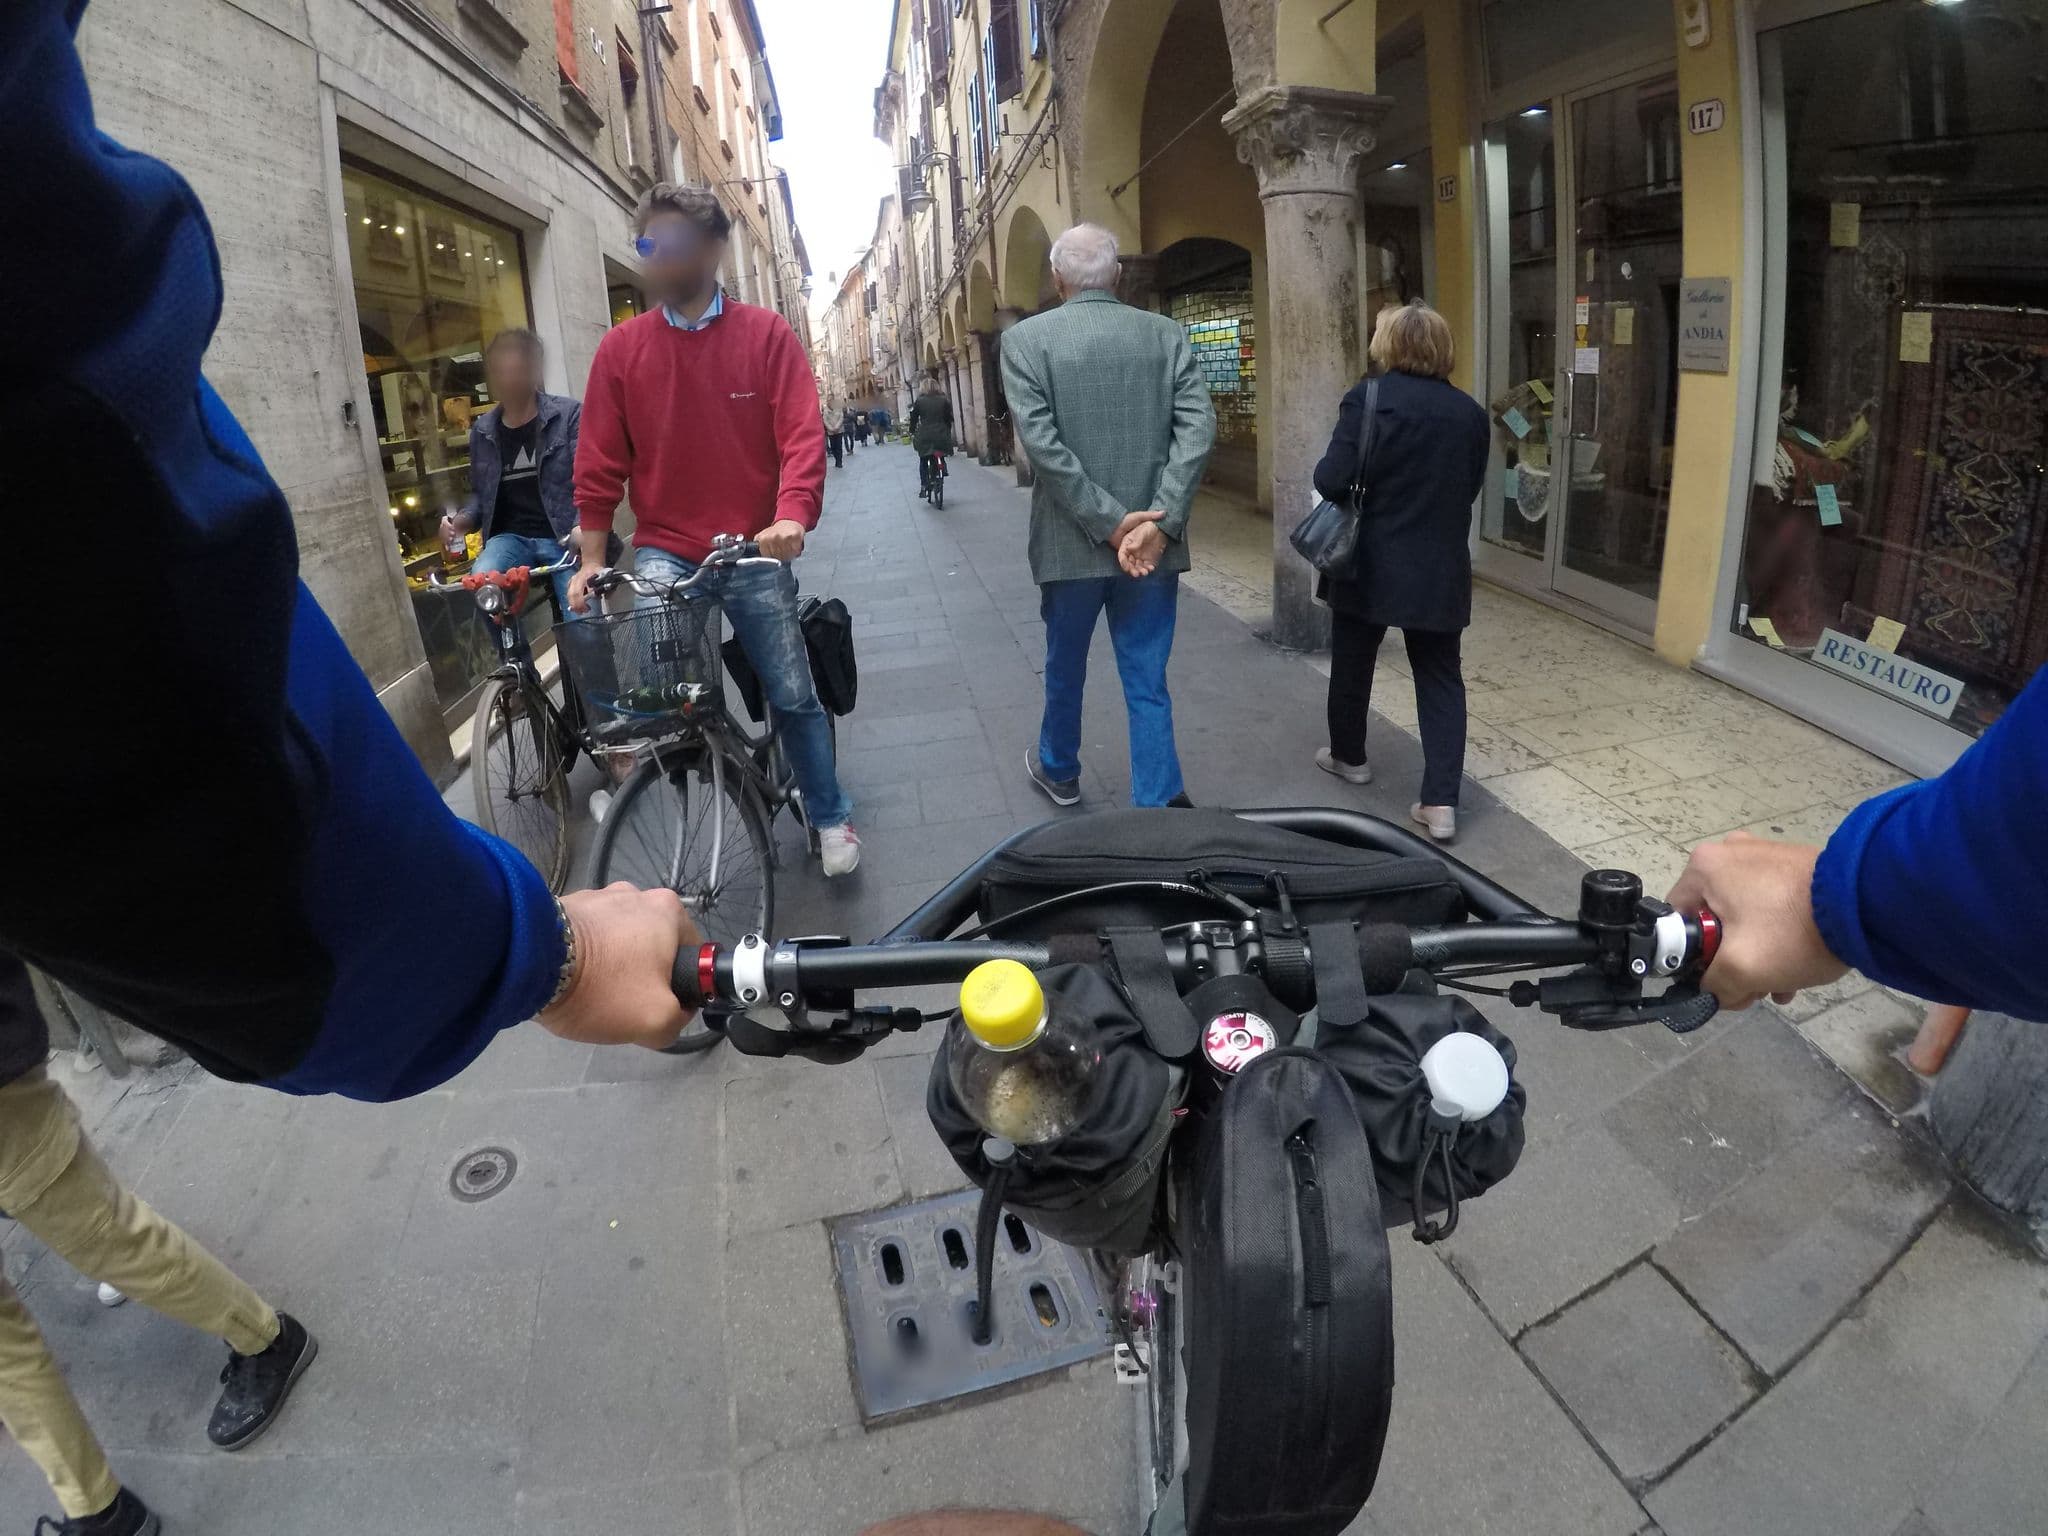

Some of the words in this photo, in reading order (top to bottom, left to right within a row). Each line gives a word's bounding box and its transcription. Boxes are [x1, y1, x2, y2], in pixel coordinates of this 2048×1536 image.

[1691, 107, 1713, 130] 117
[1684, 327, 1724, 341] ANDIA
[1822, 638, 1951, 705] RESTAURO
